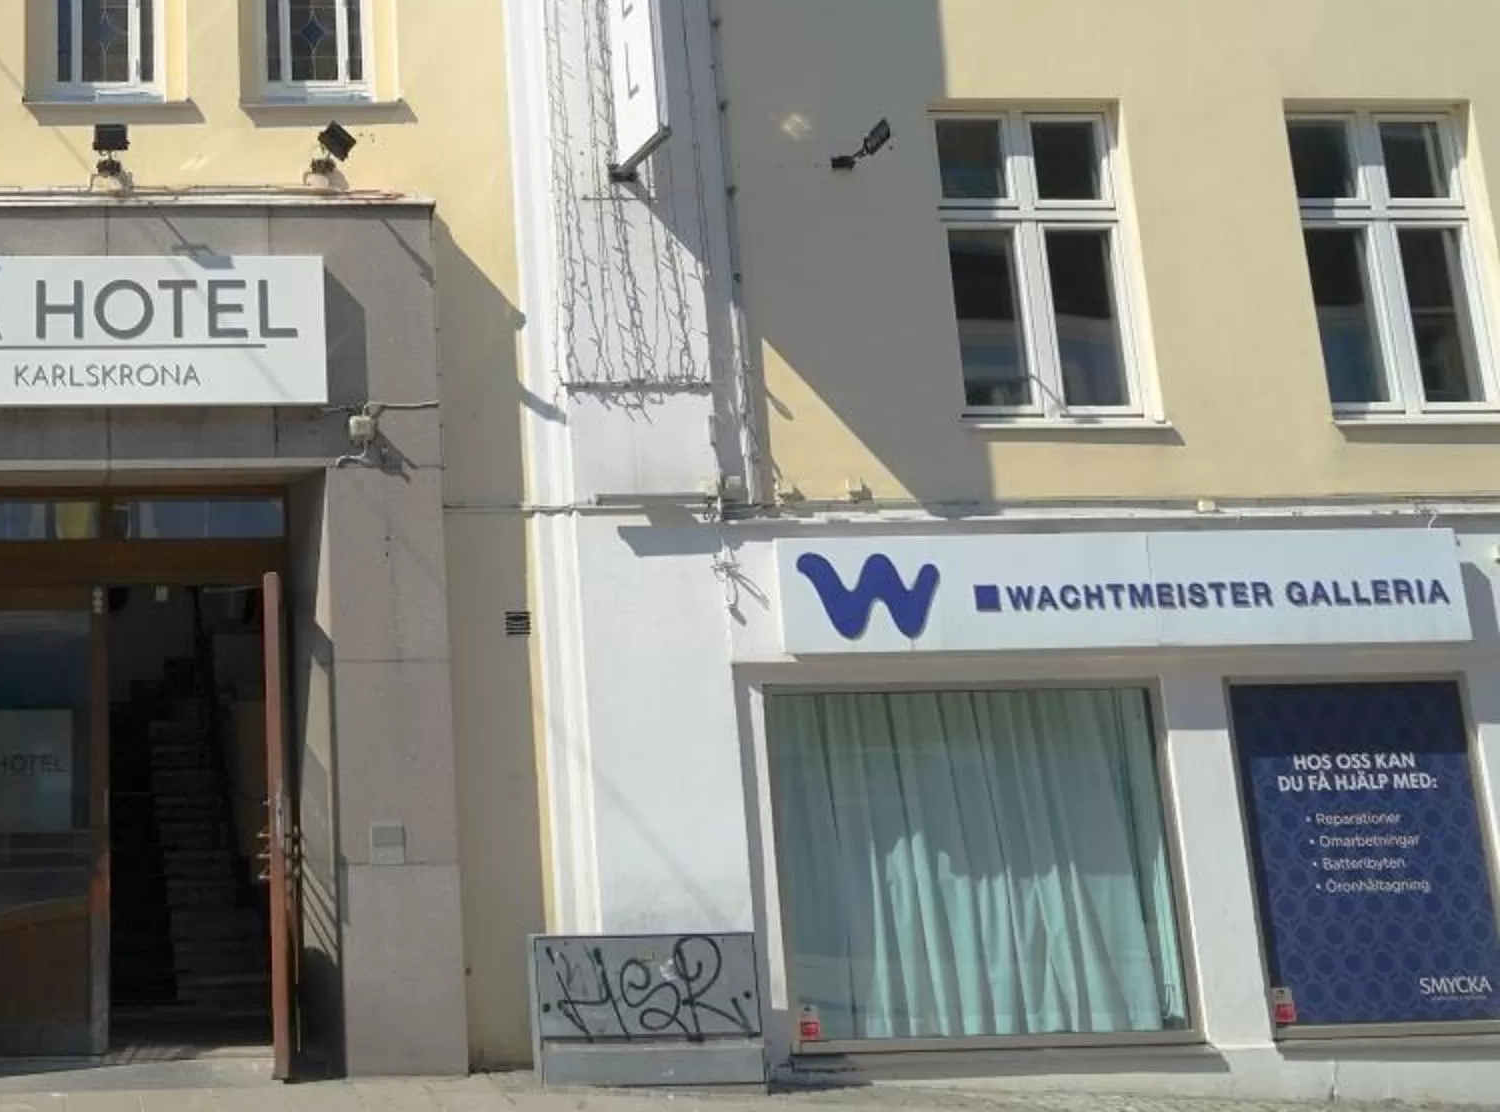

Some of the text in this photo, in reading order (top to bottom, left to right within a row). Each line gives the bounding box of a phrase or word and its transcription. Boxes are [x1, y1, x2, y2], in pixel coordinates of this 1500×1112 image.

[35, 279, 299, 340] HOTEL
[14, 363, 201, 388] KARLSKRONA
[1005, 578, 1450, 612] WACHTMEISTER GALLERIA
[1293, 752, 1415, 770] HOS OSS KAN
[1277, 771, 1438, 792] DU FÅ HJÄLP MED:
[1419, 976, 1493, 995] SMYCKA
